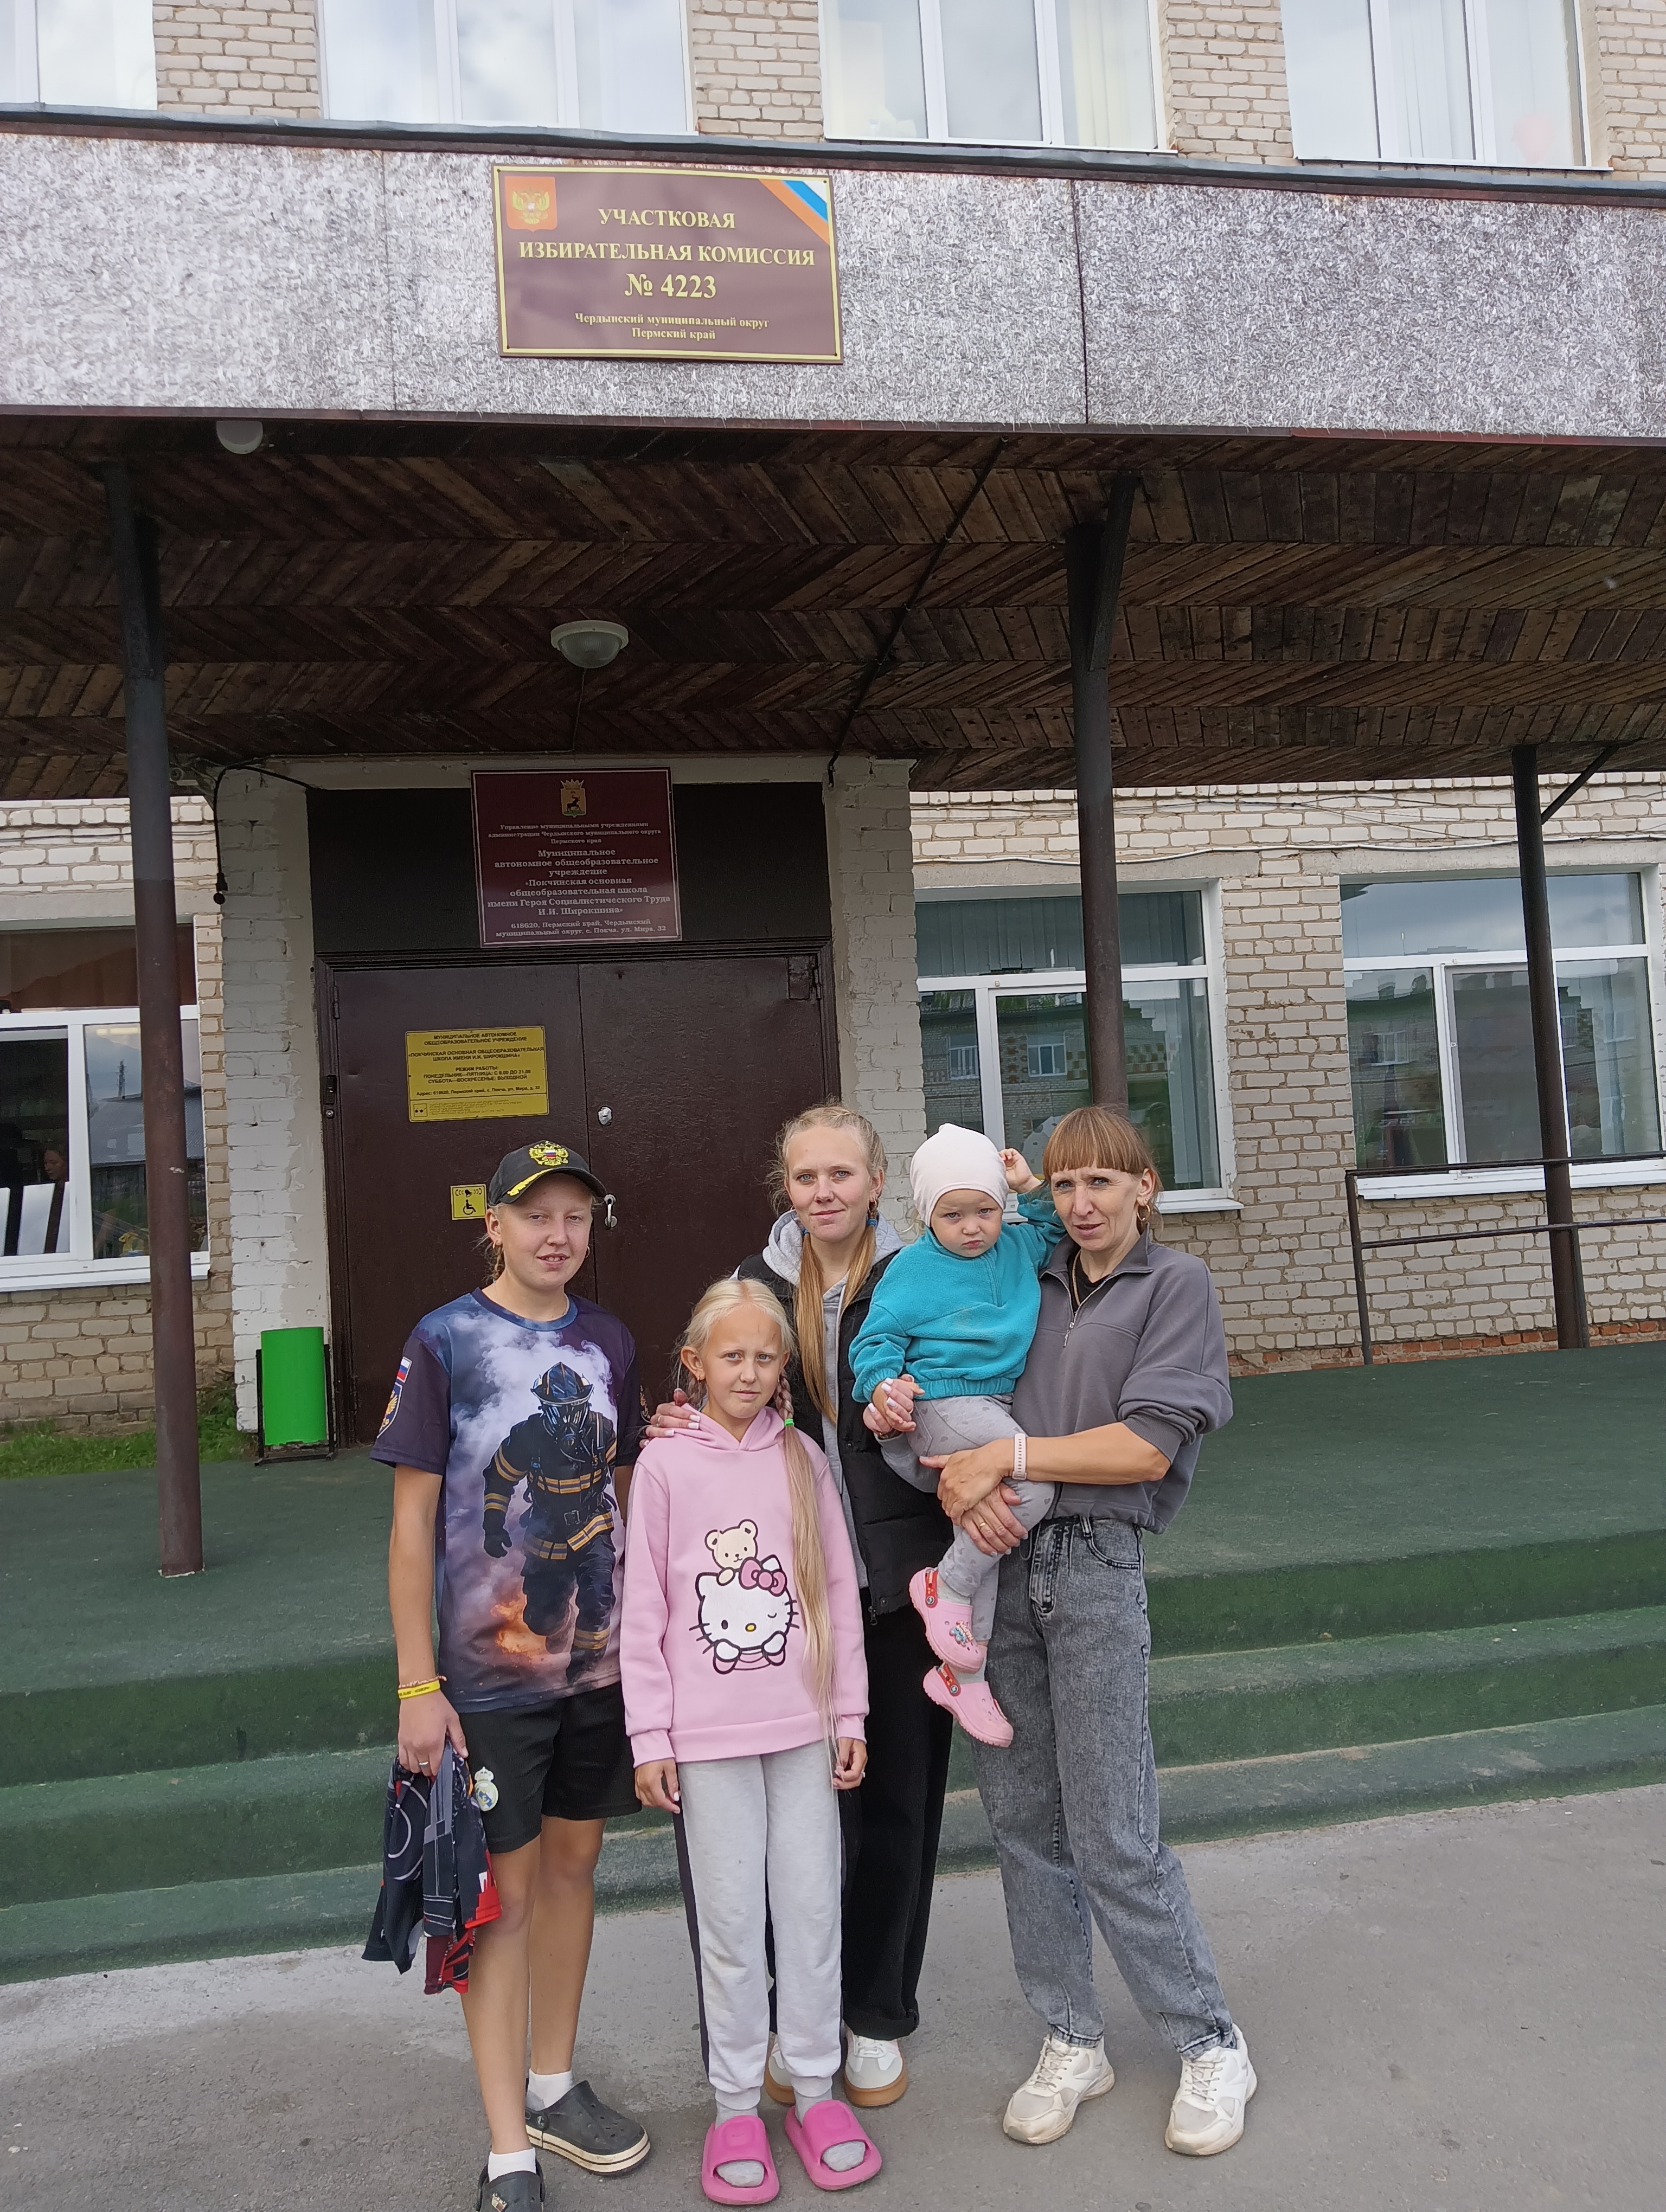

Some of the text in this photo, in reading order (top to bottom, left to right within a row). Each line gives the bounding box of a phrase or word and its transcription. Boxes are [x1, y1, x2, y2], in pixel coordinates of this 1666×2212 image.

[598, 209, 735, 228] УЧАСТКОВАЯ
[520, 241, 815, 265] ИЗБИРАТЕЛЬНАЯ КОМИССИЯ
[624, 273, 716, 298] № 4223
[575, 312, 769, 328] Чердынский муниципальный округ
[632, 328, 716, 341] Пермский край
[538, 850, 616, 858] Муниципальное
[555, 858, 658, 867] общеобразовательное
[510, 888, 615, 897] общеобразовательная
[520, 899, 547, 907] Героя
[549, 897, 642, 905] Социалистического
[496, 929, 559, 937] муниципальный
